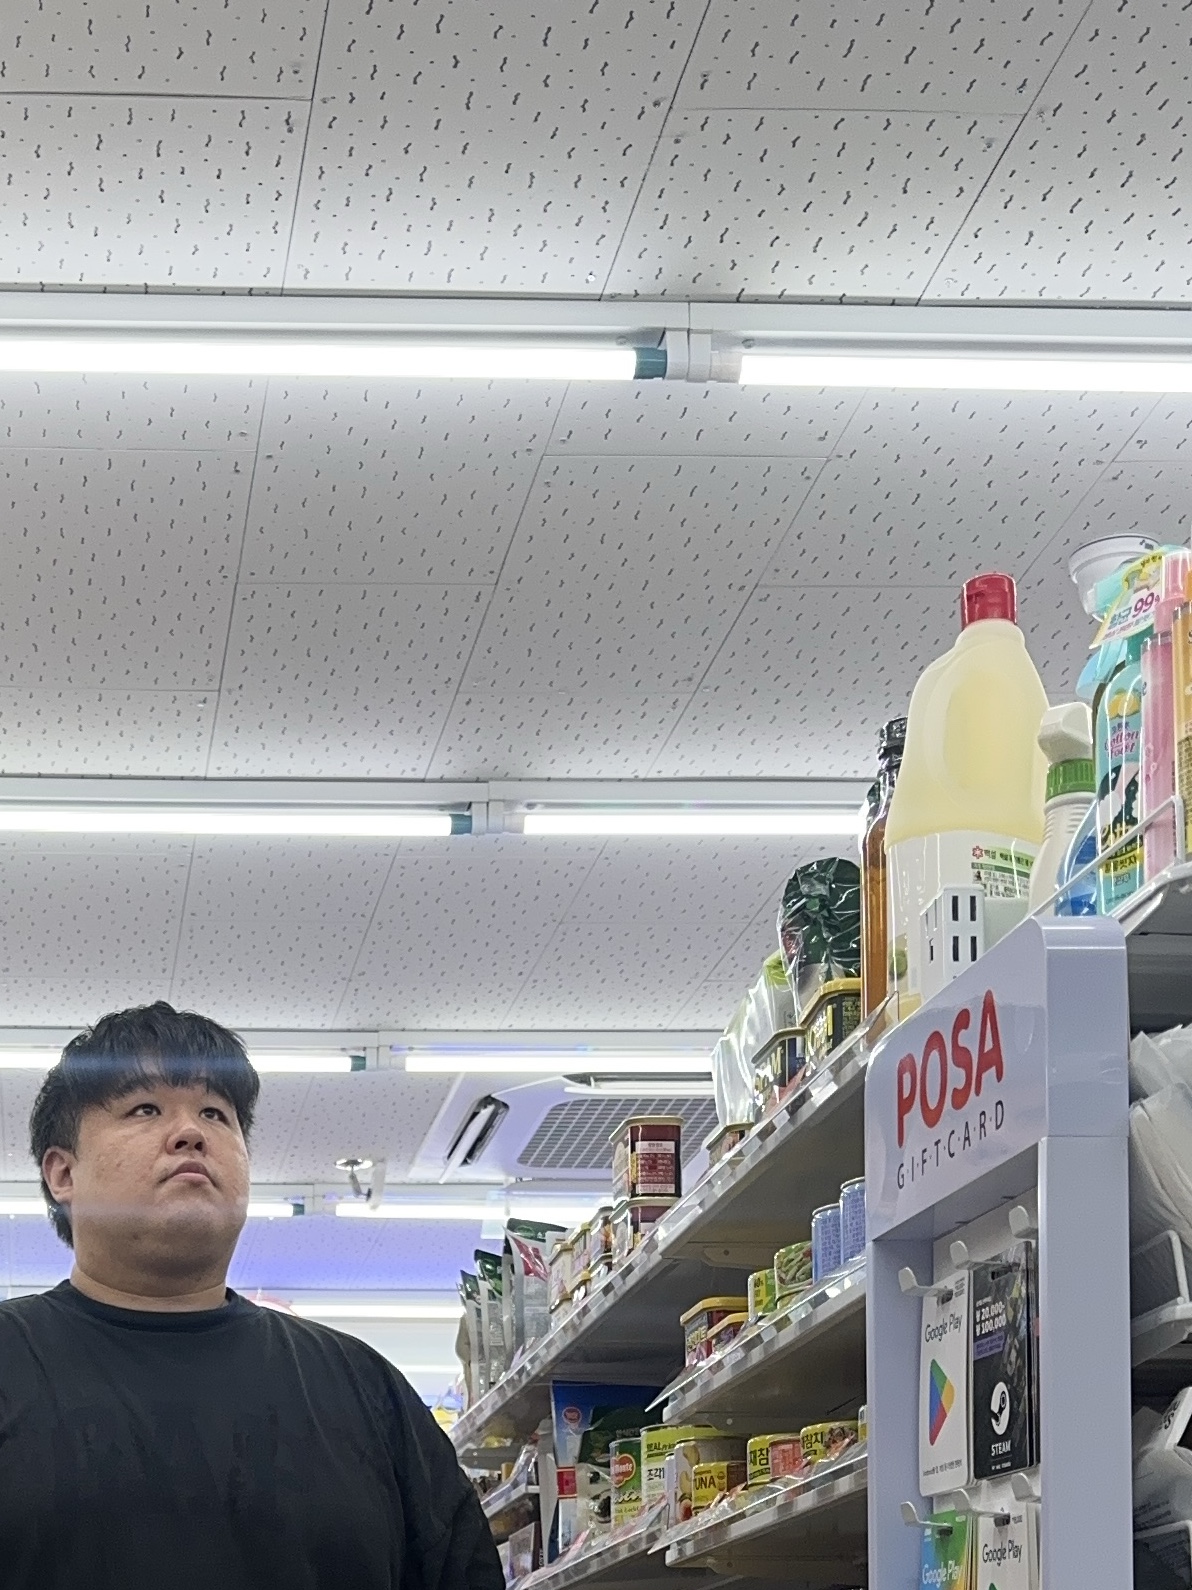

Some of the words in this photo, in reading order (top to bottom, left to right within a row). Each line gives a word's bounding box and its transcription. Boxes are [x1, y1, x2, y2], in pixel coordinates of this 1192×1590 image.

[896, 989, 1005, 1149] POSA
[924, 1319, 948, 1343] Google
[948, 1313, 964, 1334] Play
[990, 1439, 1012, 1457] STEAM
[982, 1543, 1007, 1567] Google
[1007, 1542, 1023, 1564] Play
[922, 1562, 948, 1589] Google
